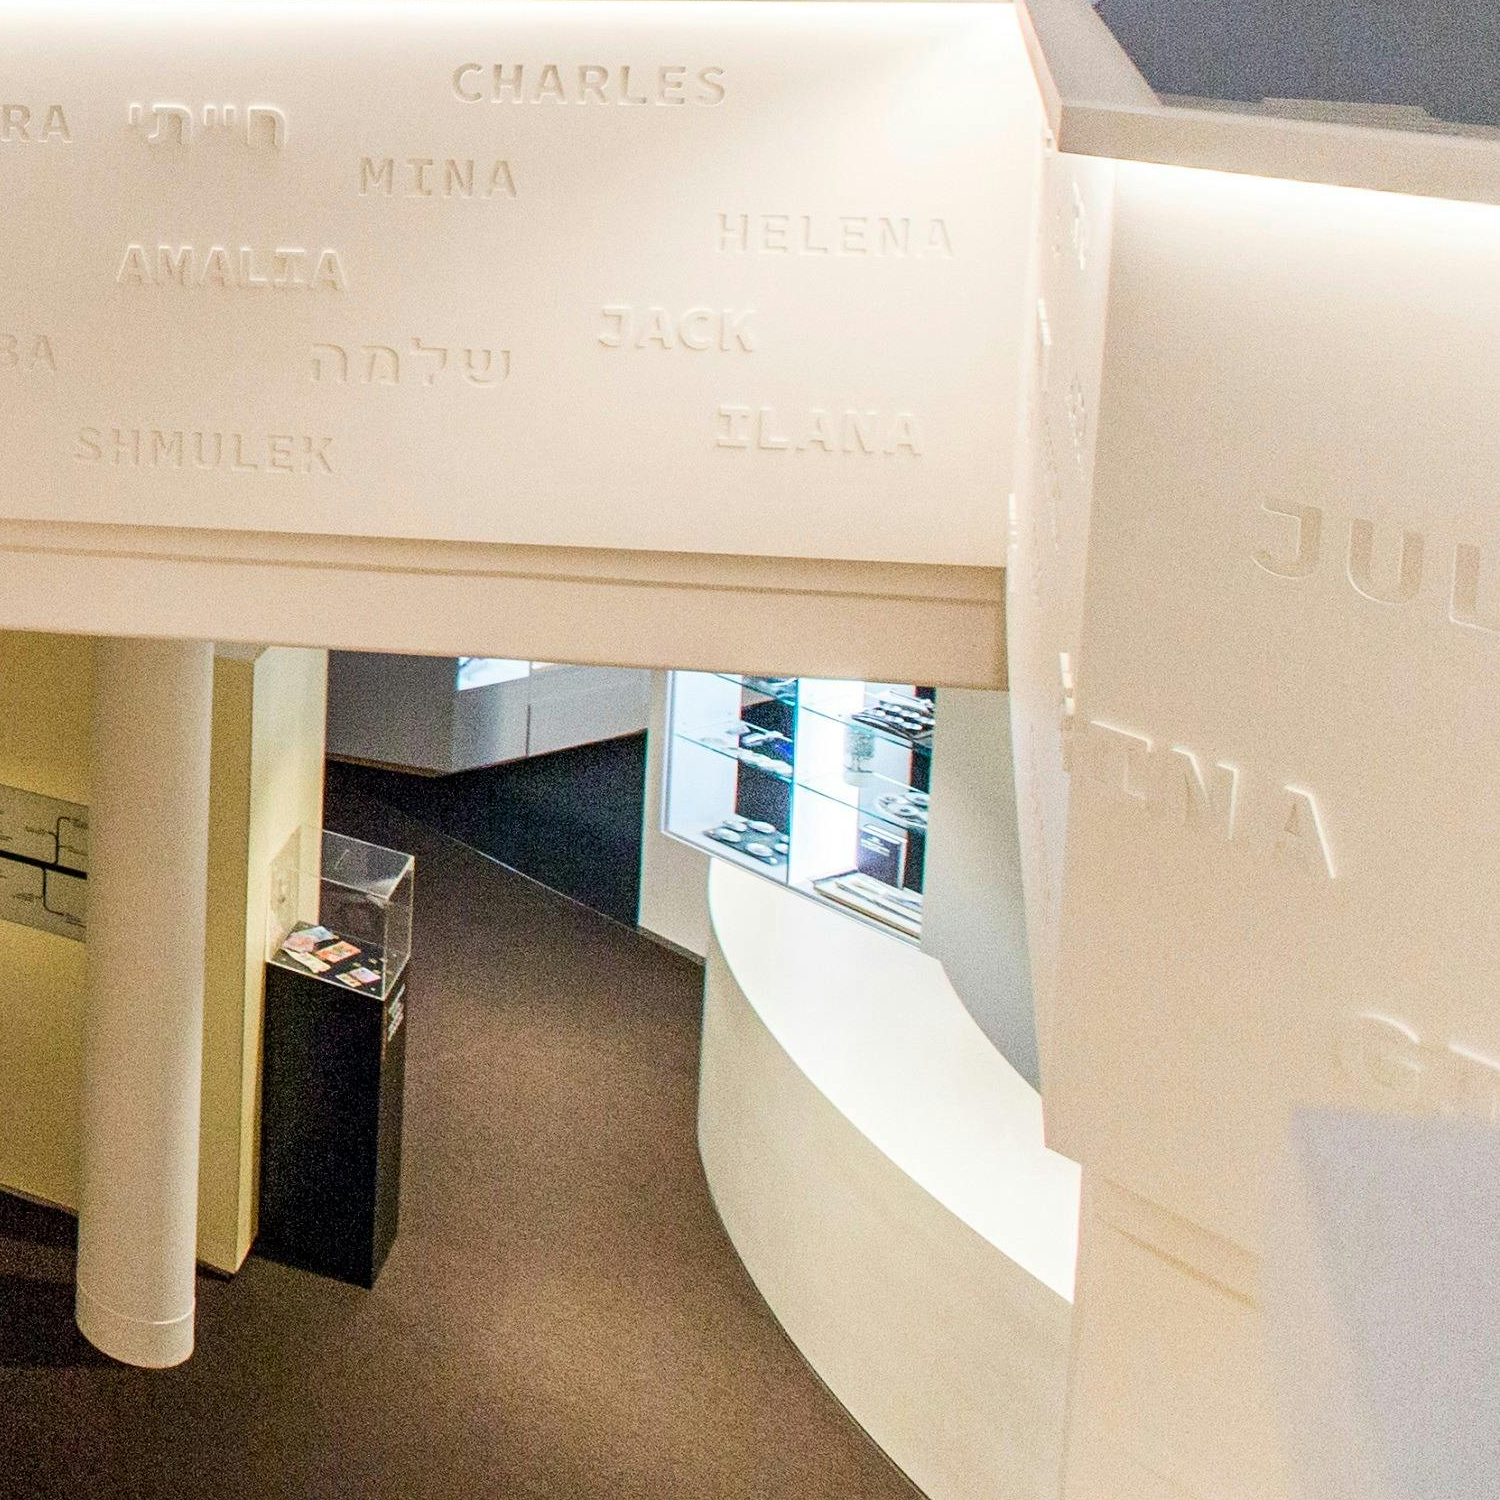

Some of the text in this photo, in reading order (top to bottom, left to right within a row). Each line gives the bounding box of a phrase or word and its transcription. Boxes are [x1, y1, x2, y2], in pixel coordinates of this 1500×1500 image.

[451, 60, 729, 110] CHARLES
[357, 155, 521, 204] MINA
[714, 210, 959, 263] HELENA
[114, 238, 351, 297] AMALIA
[597, 301, 764, 359] JACK
[307, 332, 517, 390] שלמה
[71, 421, 338, 477] SHMULEK
[713, 403, 928, 459] ILANA
